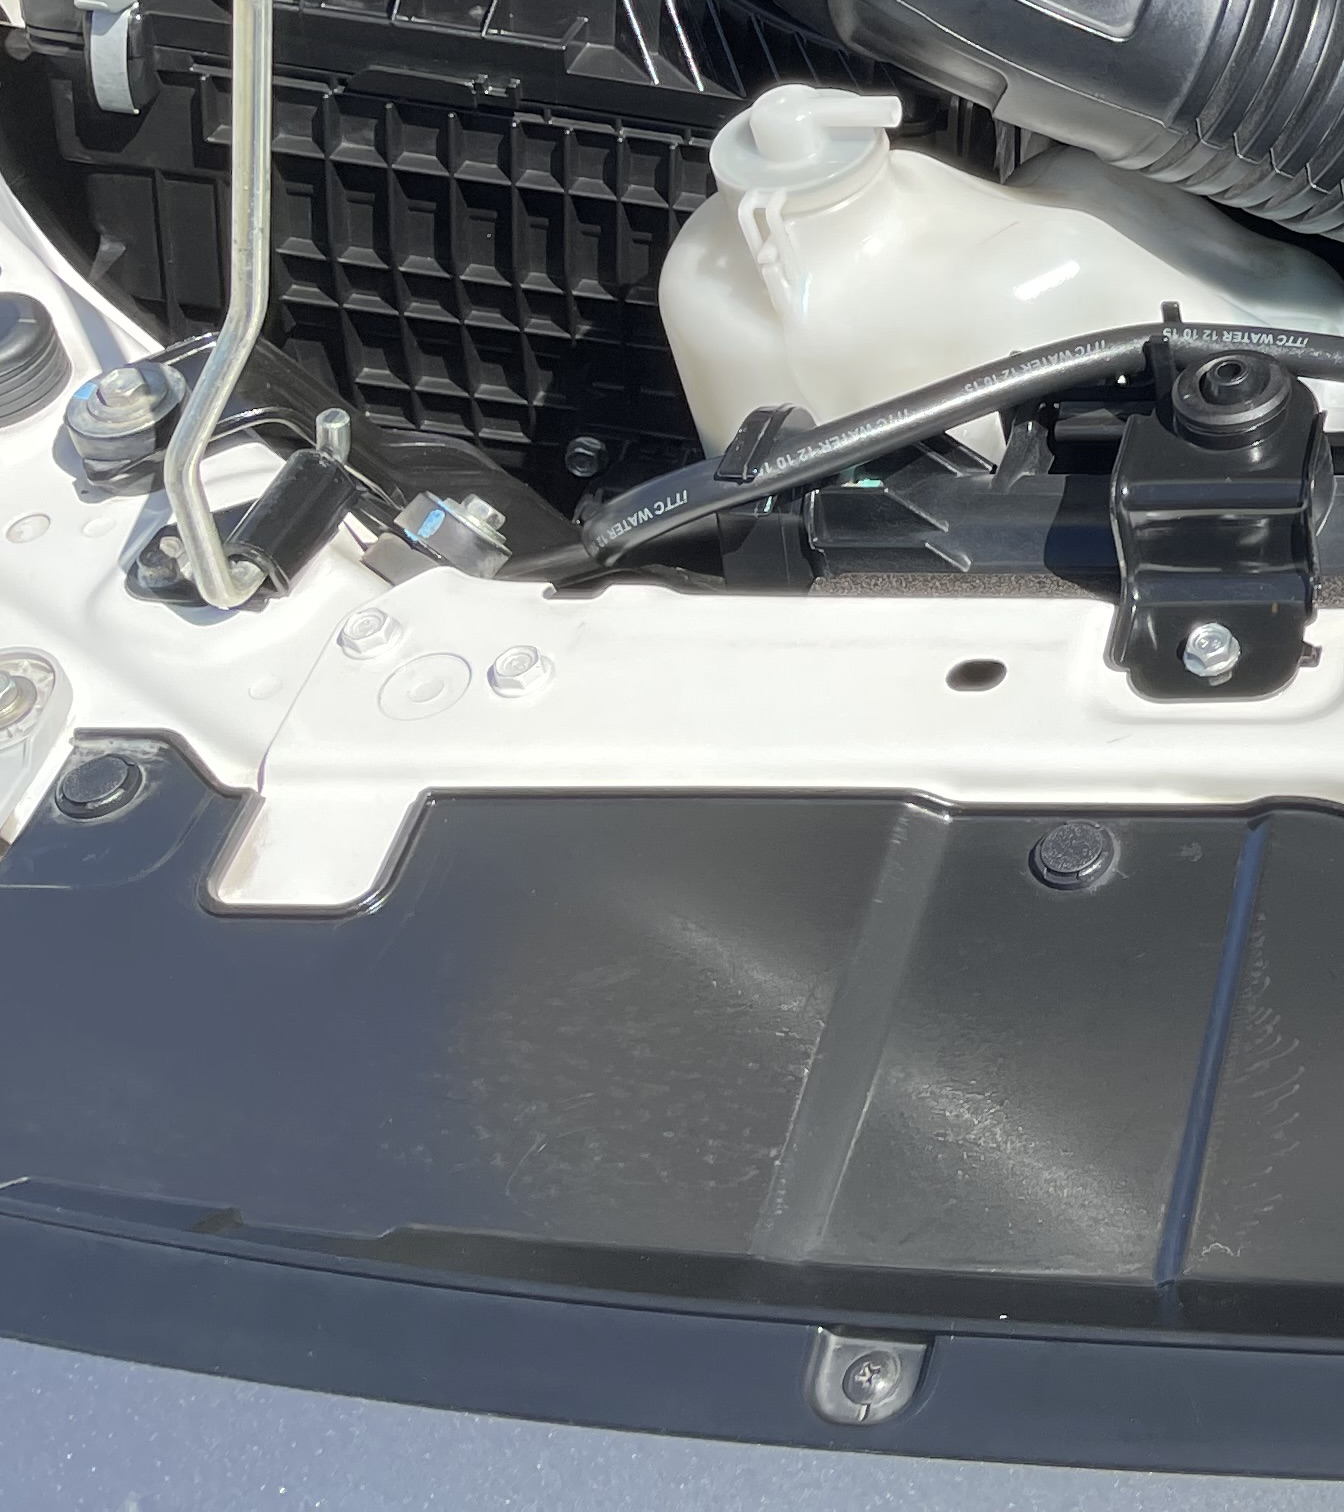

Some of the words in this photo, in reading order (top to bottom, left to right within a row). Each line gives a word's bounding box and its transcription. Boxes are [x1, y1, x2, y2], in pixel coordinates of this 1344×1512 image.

[1183, 328, 1199, 339] 10
[1202, 329, 1218, 341] 12
[1222, 330, 1274, 345] WATER
[1275, 334, 1309, 348] ITTC
[1074, 339, 1106, 357] ITTC
[1019, 349, 1073, 372] WATER
[1001, 367, 1017, 379] 12
[817, 423, 874, 454] WATER
[796, 445, 815, 462] 12
[775, 454, 794, 469] 10
[653, 489, 688, 515] ITTC
[606, 507, 654, 540] WATER
[595, 534, 609, 548] 12
